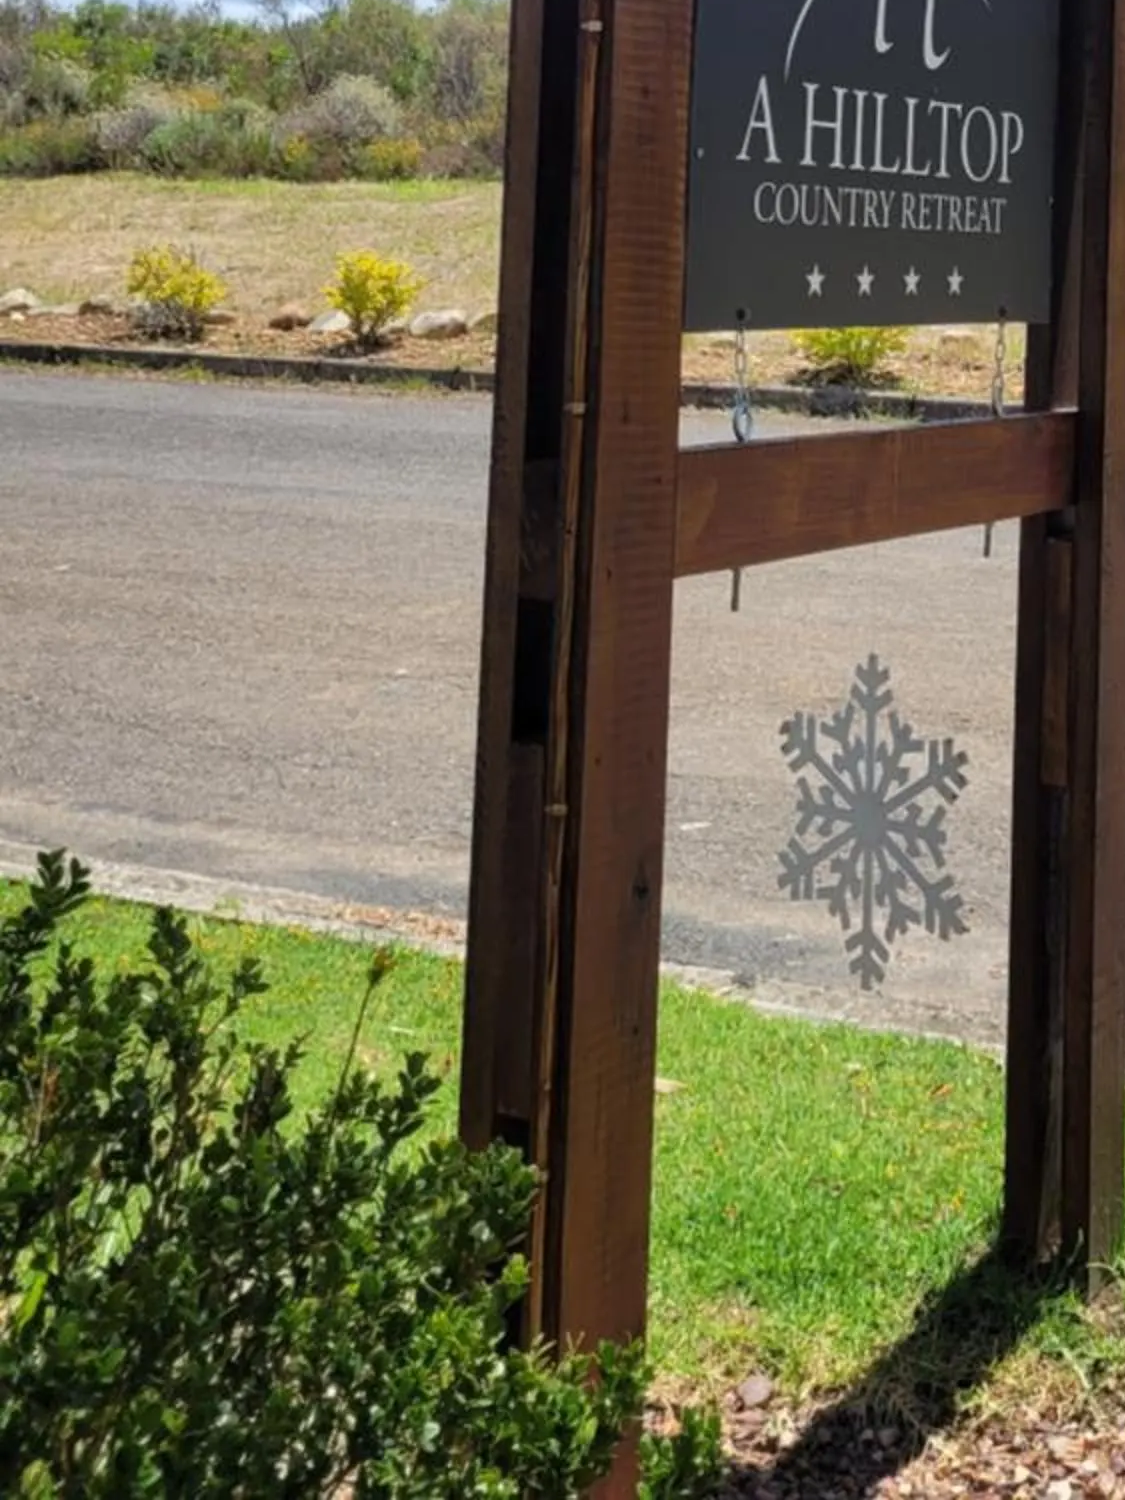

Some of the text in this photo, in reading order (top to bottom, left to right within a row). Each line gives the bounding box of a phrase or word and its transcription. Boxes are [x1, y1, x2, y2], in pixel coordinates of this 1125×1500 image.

[735, 74, 1025, 184] A HILLTOP
[753, 180, 1007, 235] COUNTRY RETREAT
